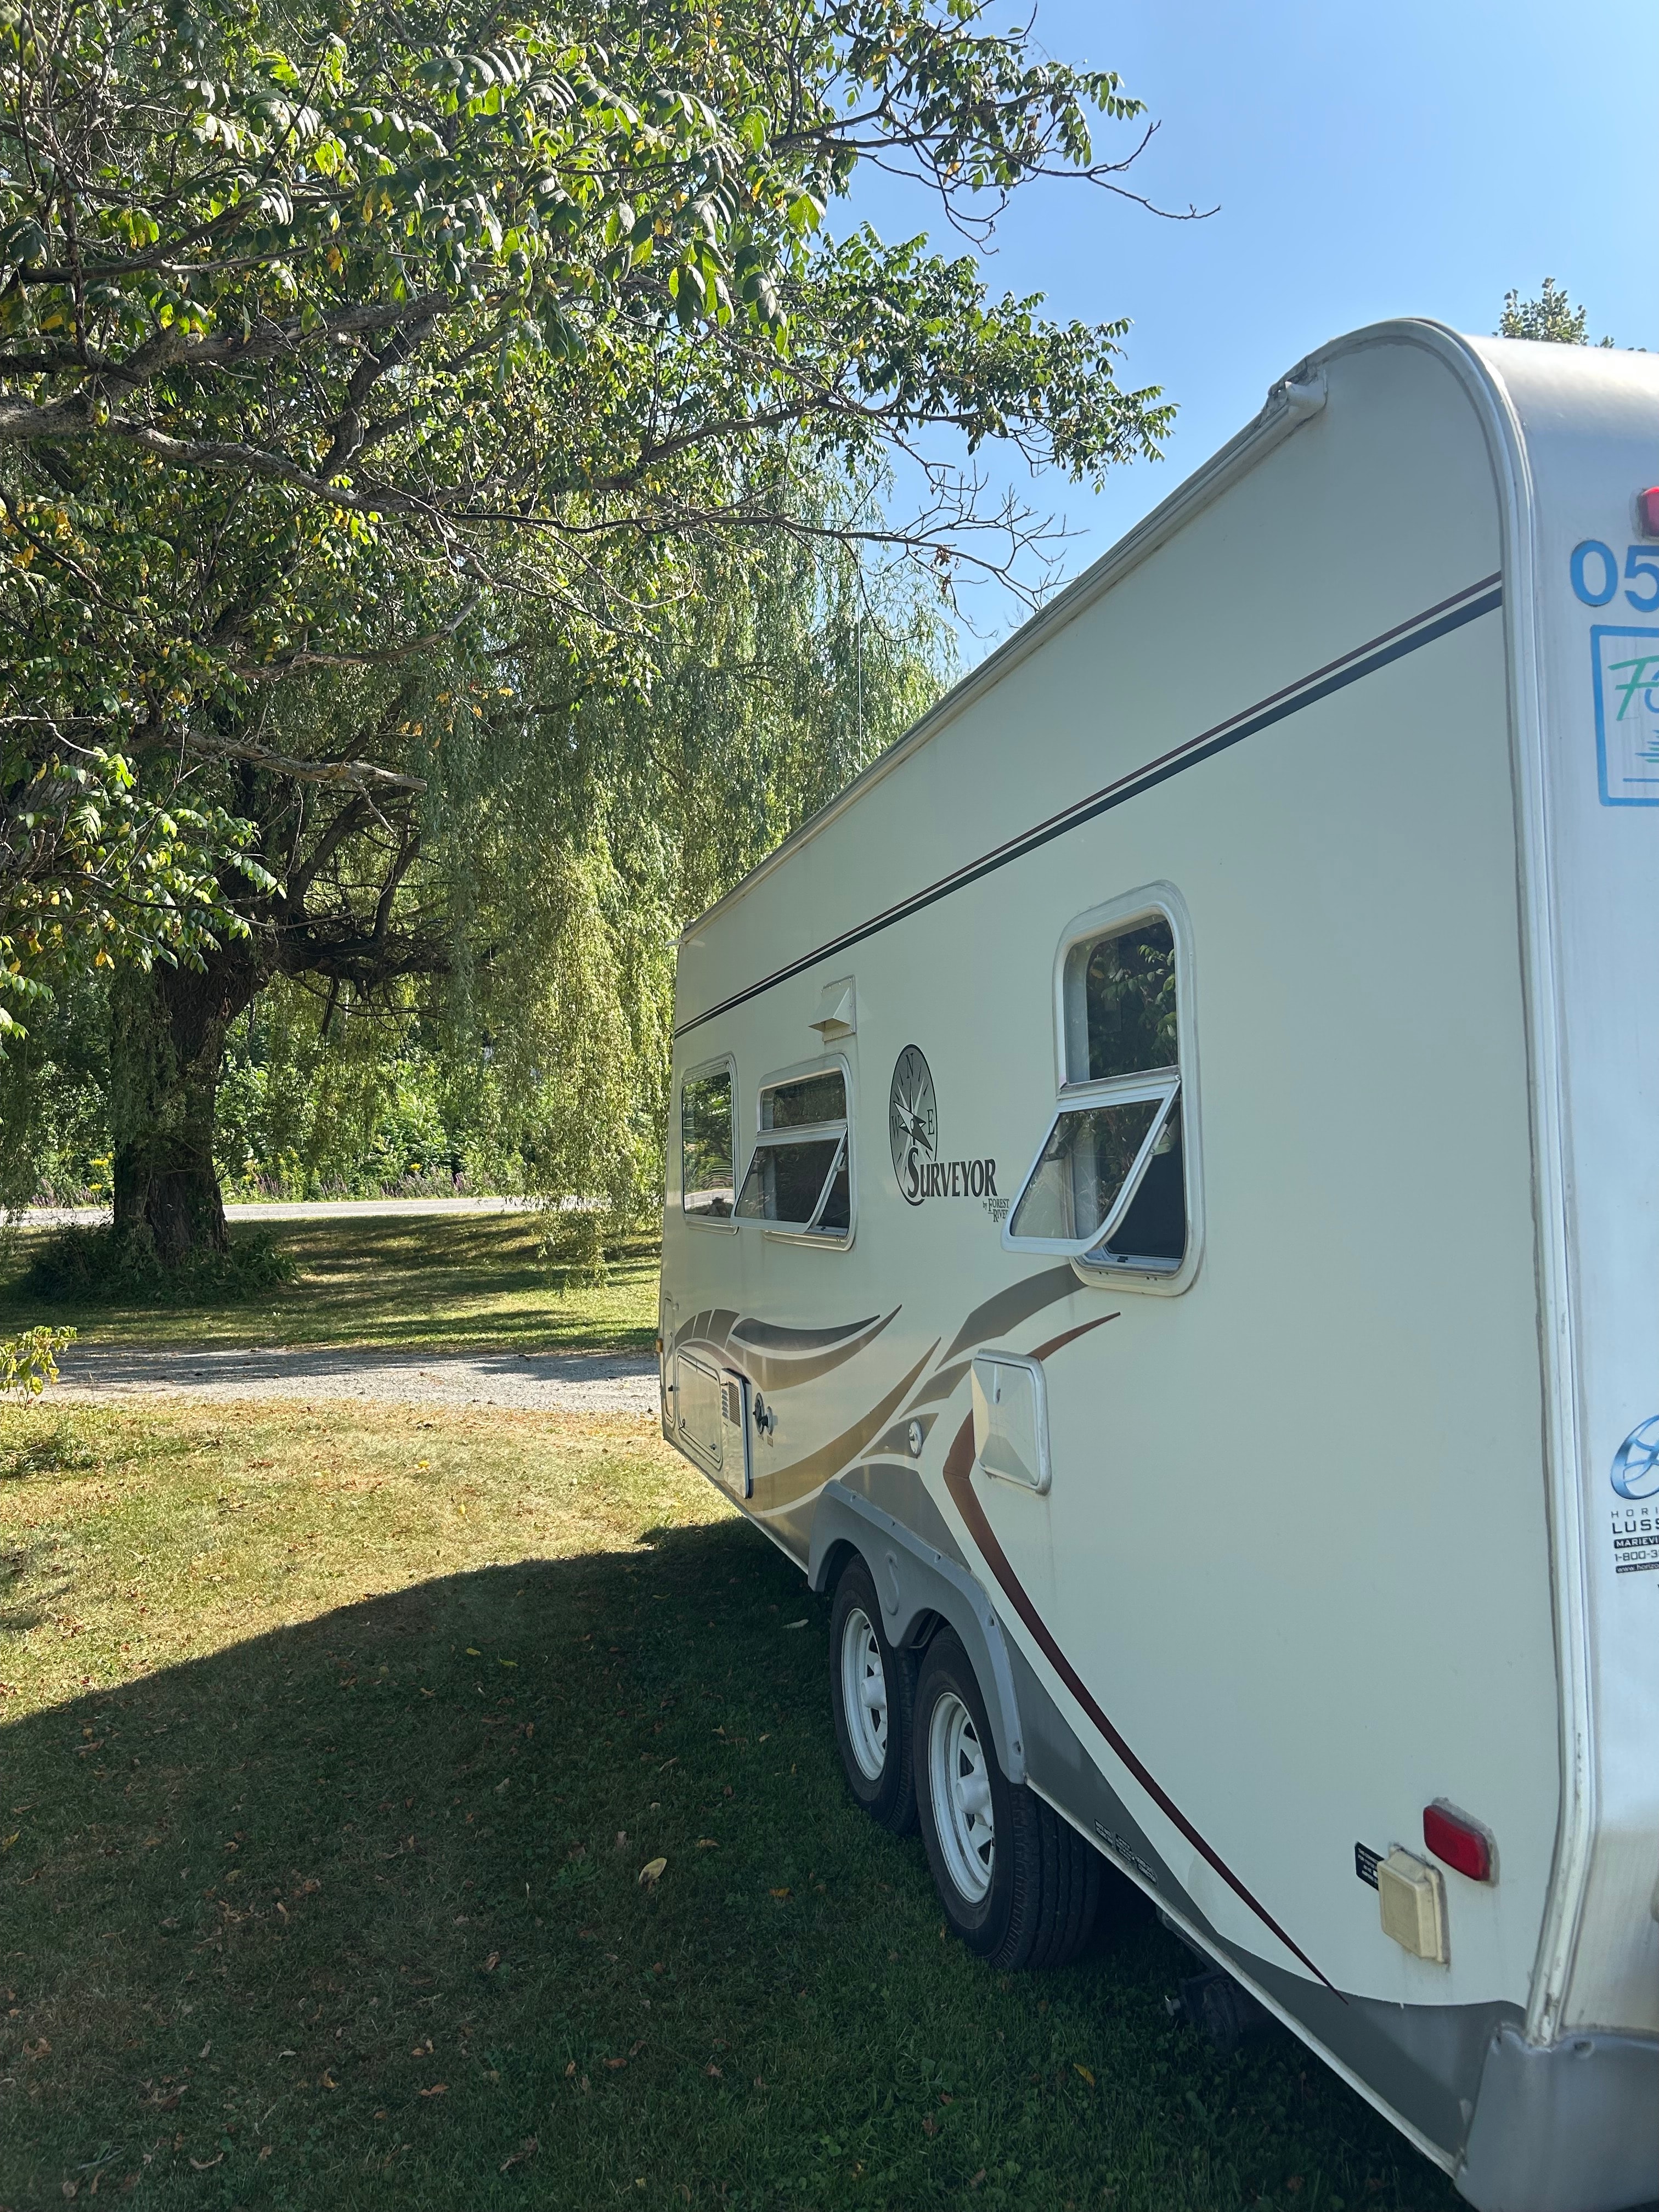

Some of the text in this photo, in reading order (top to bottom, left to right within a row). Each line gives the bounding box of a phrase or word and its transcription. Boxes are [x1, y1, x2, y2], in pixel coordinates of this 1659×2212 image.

[905, 1052, 915, 1079] N
[891, 1108, 935, 1140] W E
[907, 1147, 998, 1198] SURVEYOR
[982, 1198, 1009, 1212] by FOREST
